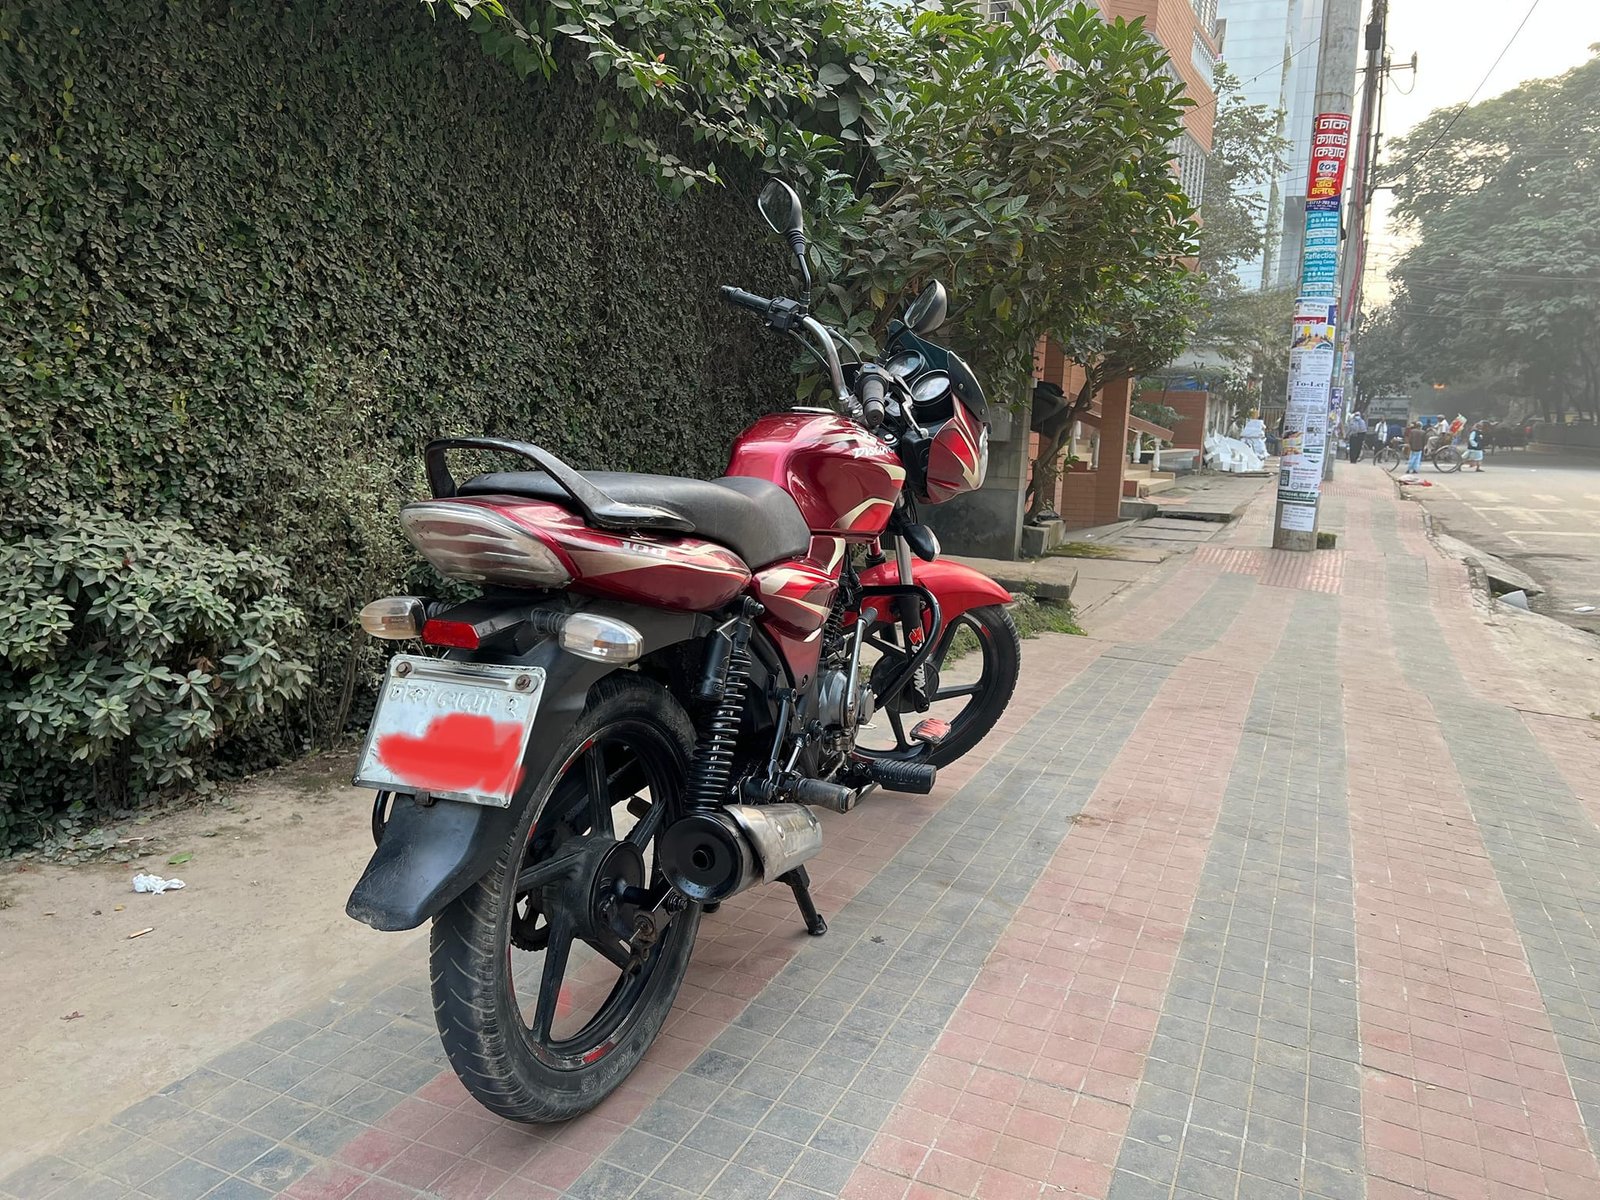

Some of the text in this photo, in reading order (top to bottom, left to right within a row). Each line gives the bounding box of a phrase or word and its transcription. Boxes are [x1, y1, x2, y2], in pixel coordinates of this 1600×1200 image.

[1320, 119, 1350, 131] ঢাকা
[1316, 132, 1348, 146] ক্যাডেট
[1314, 147, 1346, 160] কেয়ার
[1311, 187, 1336, 196] চলছে
[1305, 252, 1336, 260] Reflection
[1296, 380, 1324, 388] To-Let
